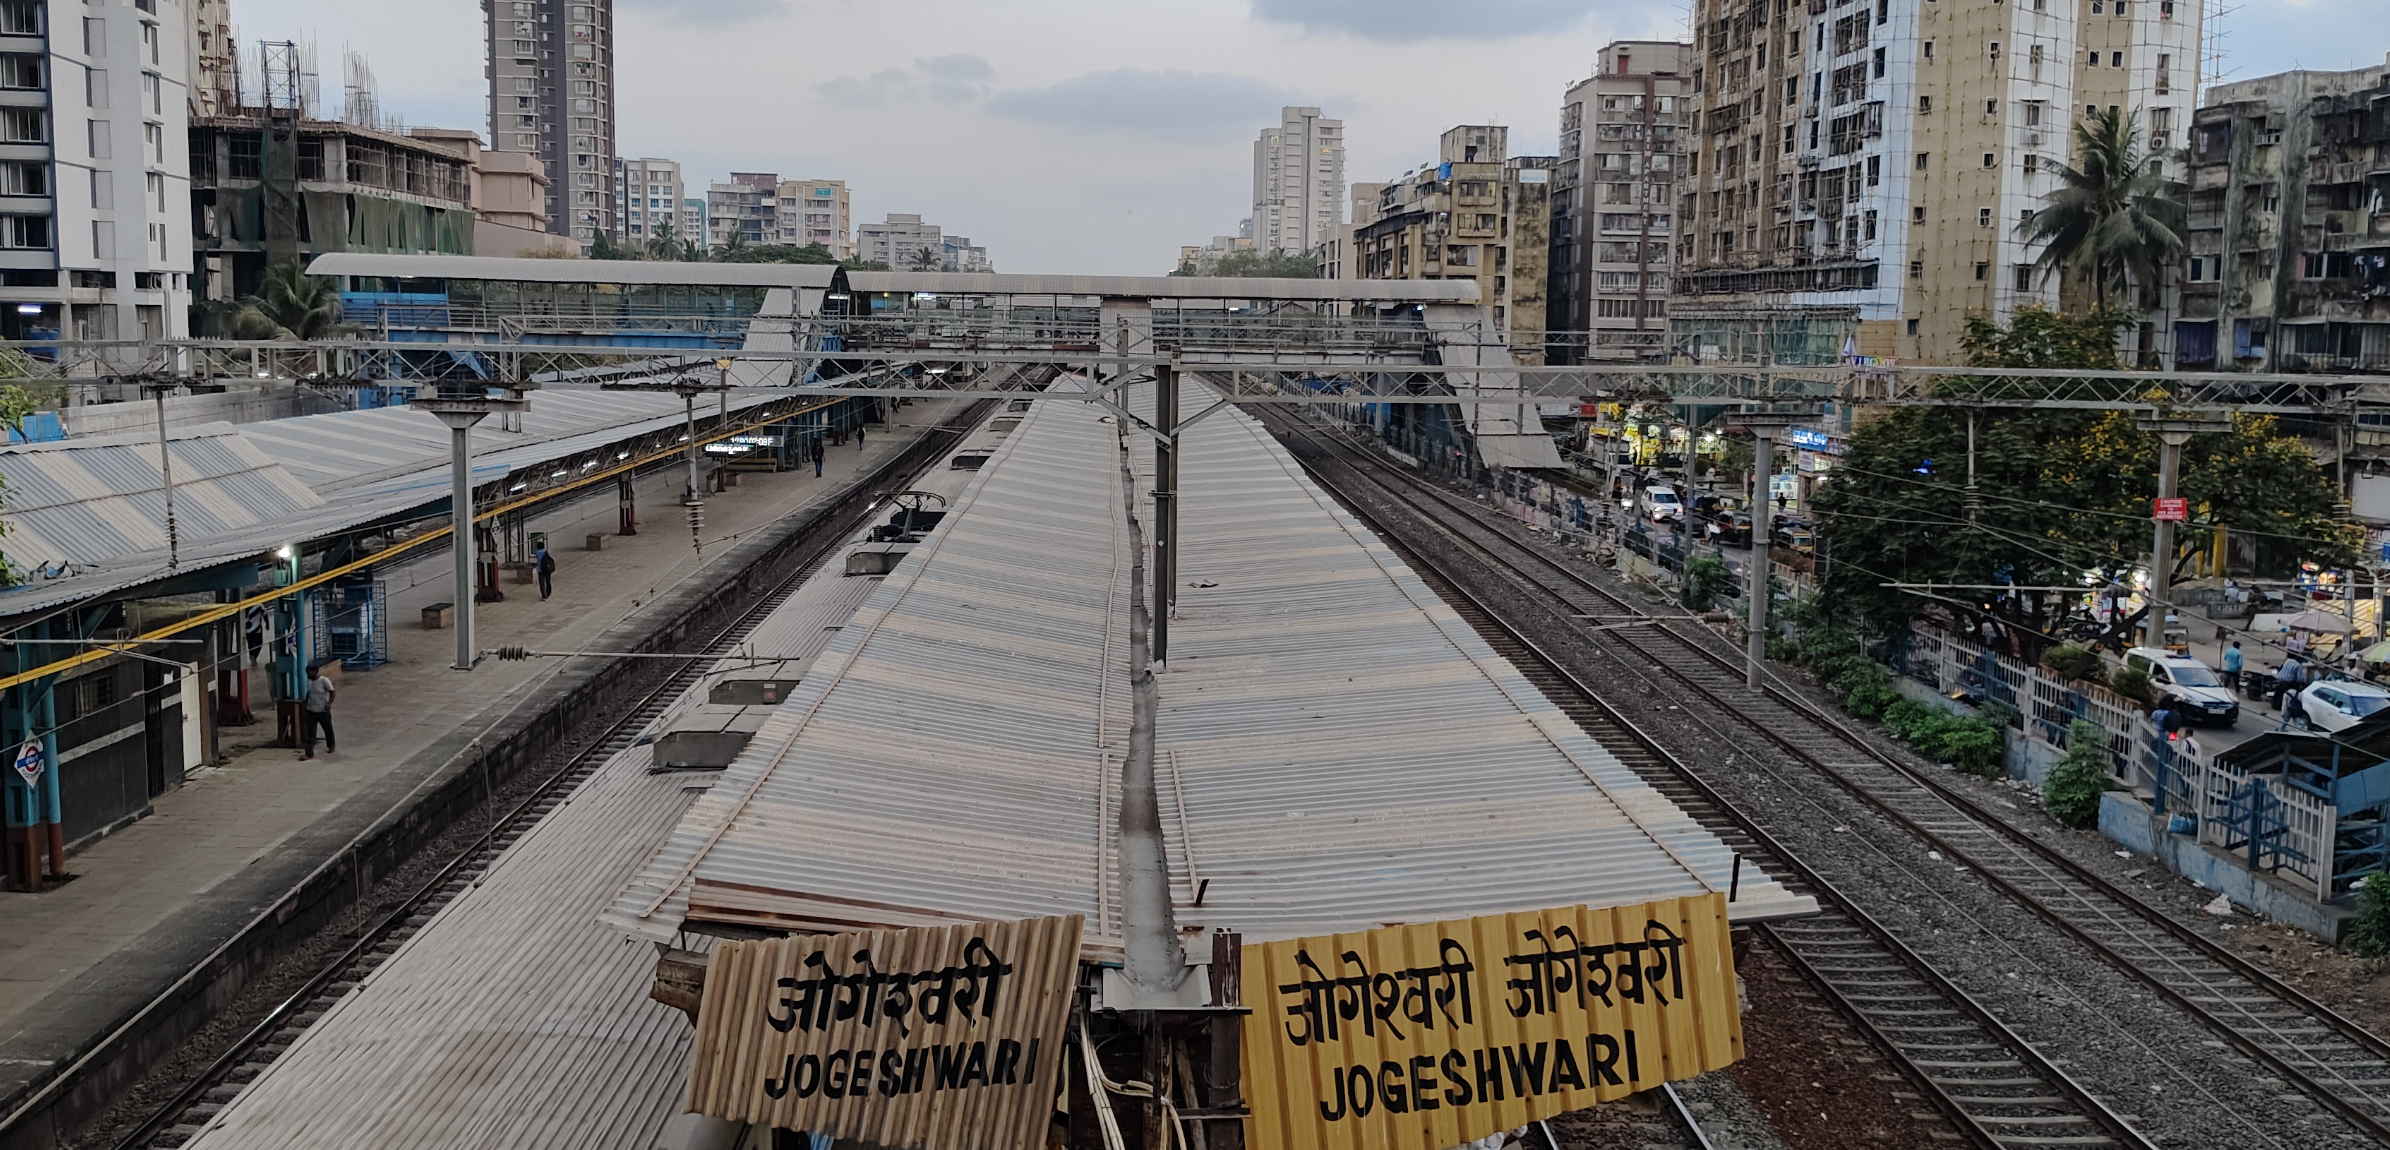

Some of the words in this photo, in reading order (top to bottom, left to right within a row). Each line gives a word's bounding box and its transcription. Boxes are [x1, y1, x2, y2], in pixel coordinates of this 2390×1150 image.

[1278, 938, 1475, 1046] जोगेश्वरी
[764, 1038, 1040, 1100] JOGESHWARI
[1320, 1029, 1640, 1122] JOGESHWARI
